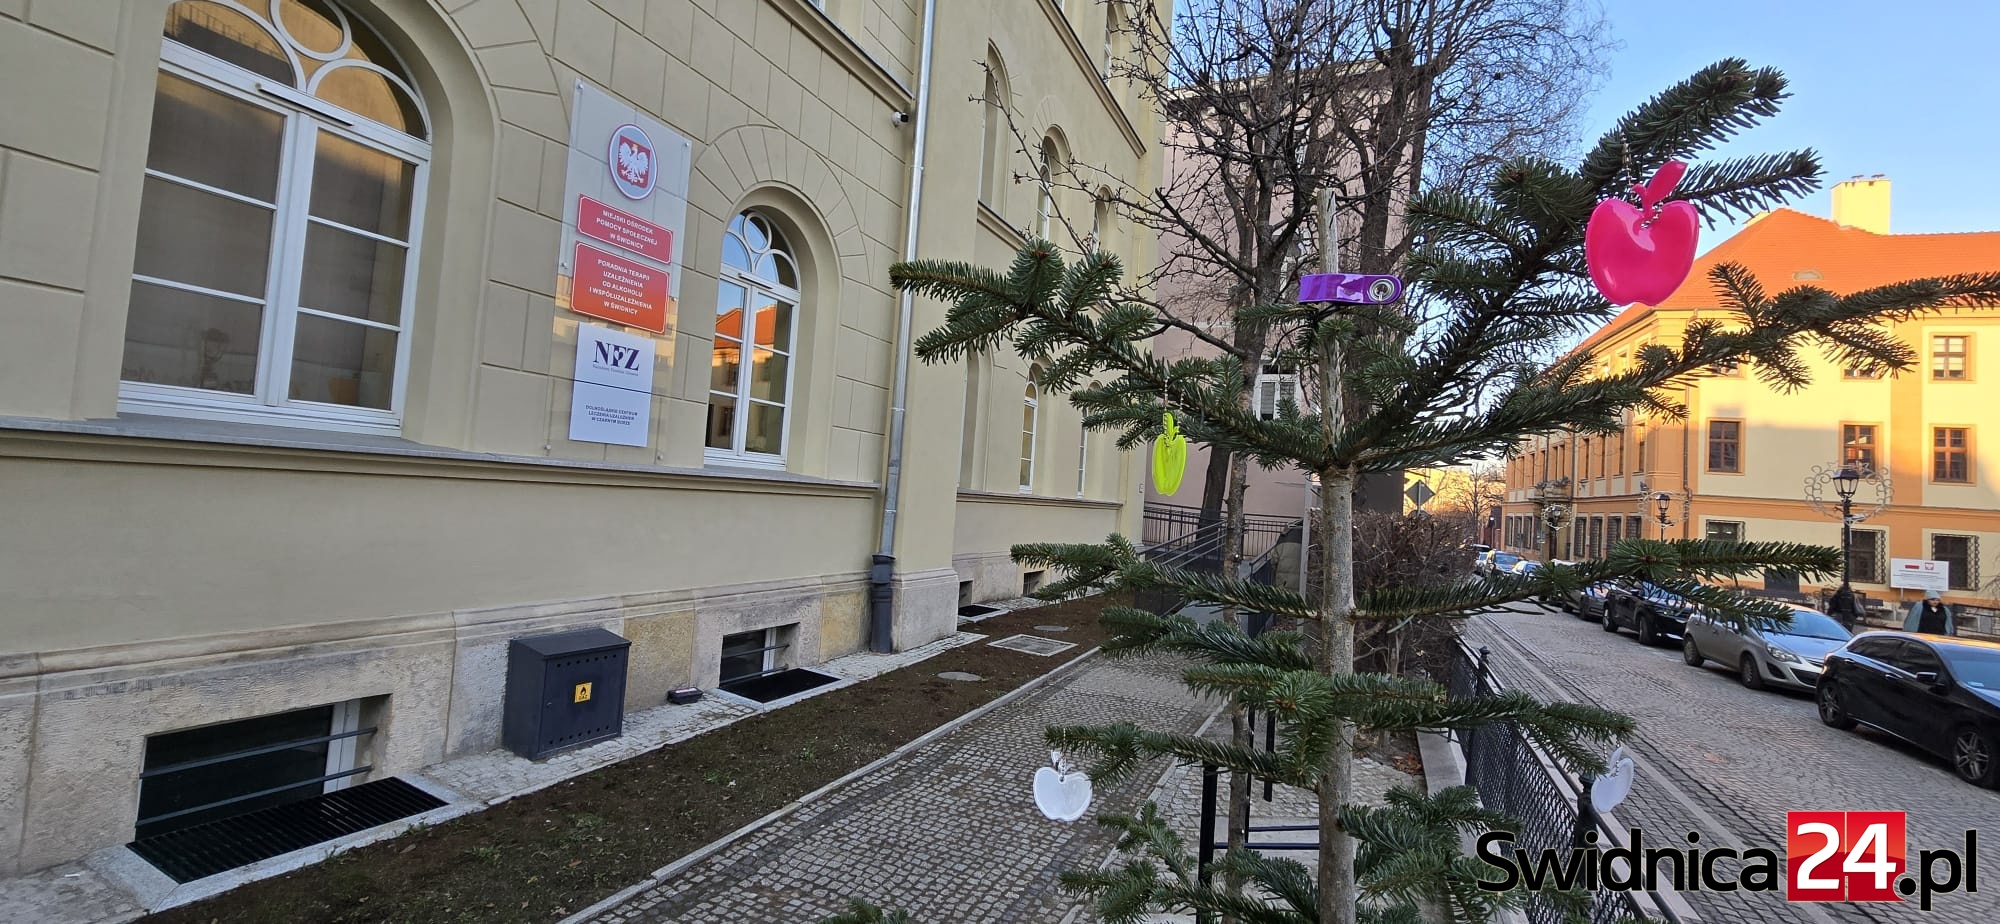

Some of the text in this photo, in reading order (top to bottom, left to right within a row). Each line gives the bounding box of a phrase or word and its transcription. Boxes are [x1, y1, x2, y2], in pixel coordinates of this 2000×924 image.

[602, 210, 626, 223] MIEJSKI
[596, 217, 658, 245] POMOCY SPOŁECZNEJ
[616, 234, 644, 249] ŚWIDNICY
[597, 259, 627, 273] PORADNIA
[611, 283, 643, 298] ALKOHOLU
[610, 301, 638, 315] ŚWIDNICY
[593, 340, 640, 371] NFZ
